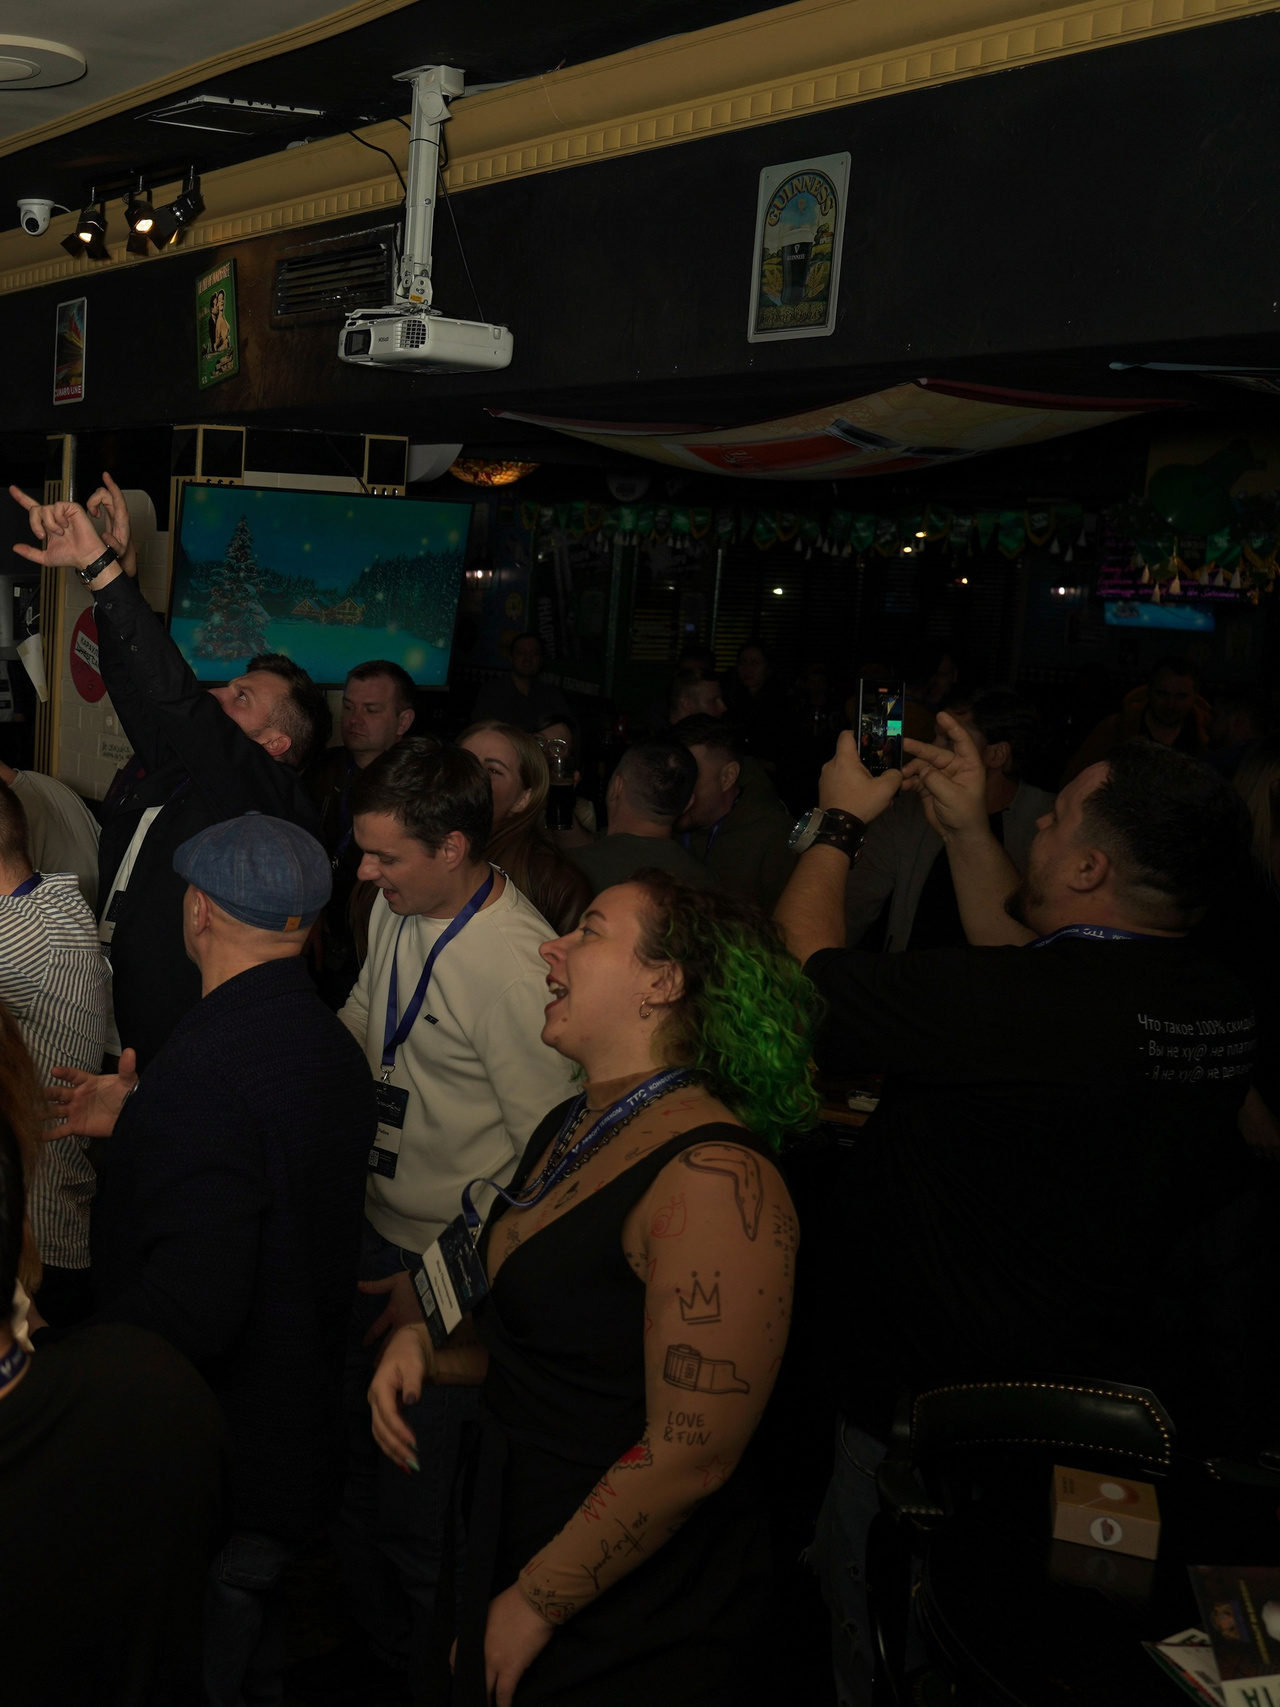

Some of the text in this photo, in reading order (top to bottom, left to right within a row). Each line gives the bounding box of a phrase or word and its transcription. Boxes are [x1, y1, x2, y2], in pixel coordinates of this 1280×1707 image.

[768, 176, 834, 227] GUINNESS
[1138, 1013, 1161, 1031] Что
[1163, 1021, 1194, 1036] такое
[1195, 1019, 1226, 1036] 100%
[1148, 1040, 1163, 1056] Вы
[1182, 1043, 1207, 1061] ху@
[1209, 1046, 1225, 1058] не
[1151, 1065, 1161, 1080] Я
[1178, 1065, 1204, 1083] ху@
[1206, 1067, 1220, 1080] не
[773, 1204, 783, 1248] TIME
[667, 1411, 706, 1428] LOVE
[676, 1430, 712, 1446] FUN
[613, 1517, 647, 1558] the
[580, 1538, 612, 1591] good
